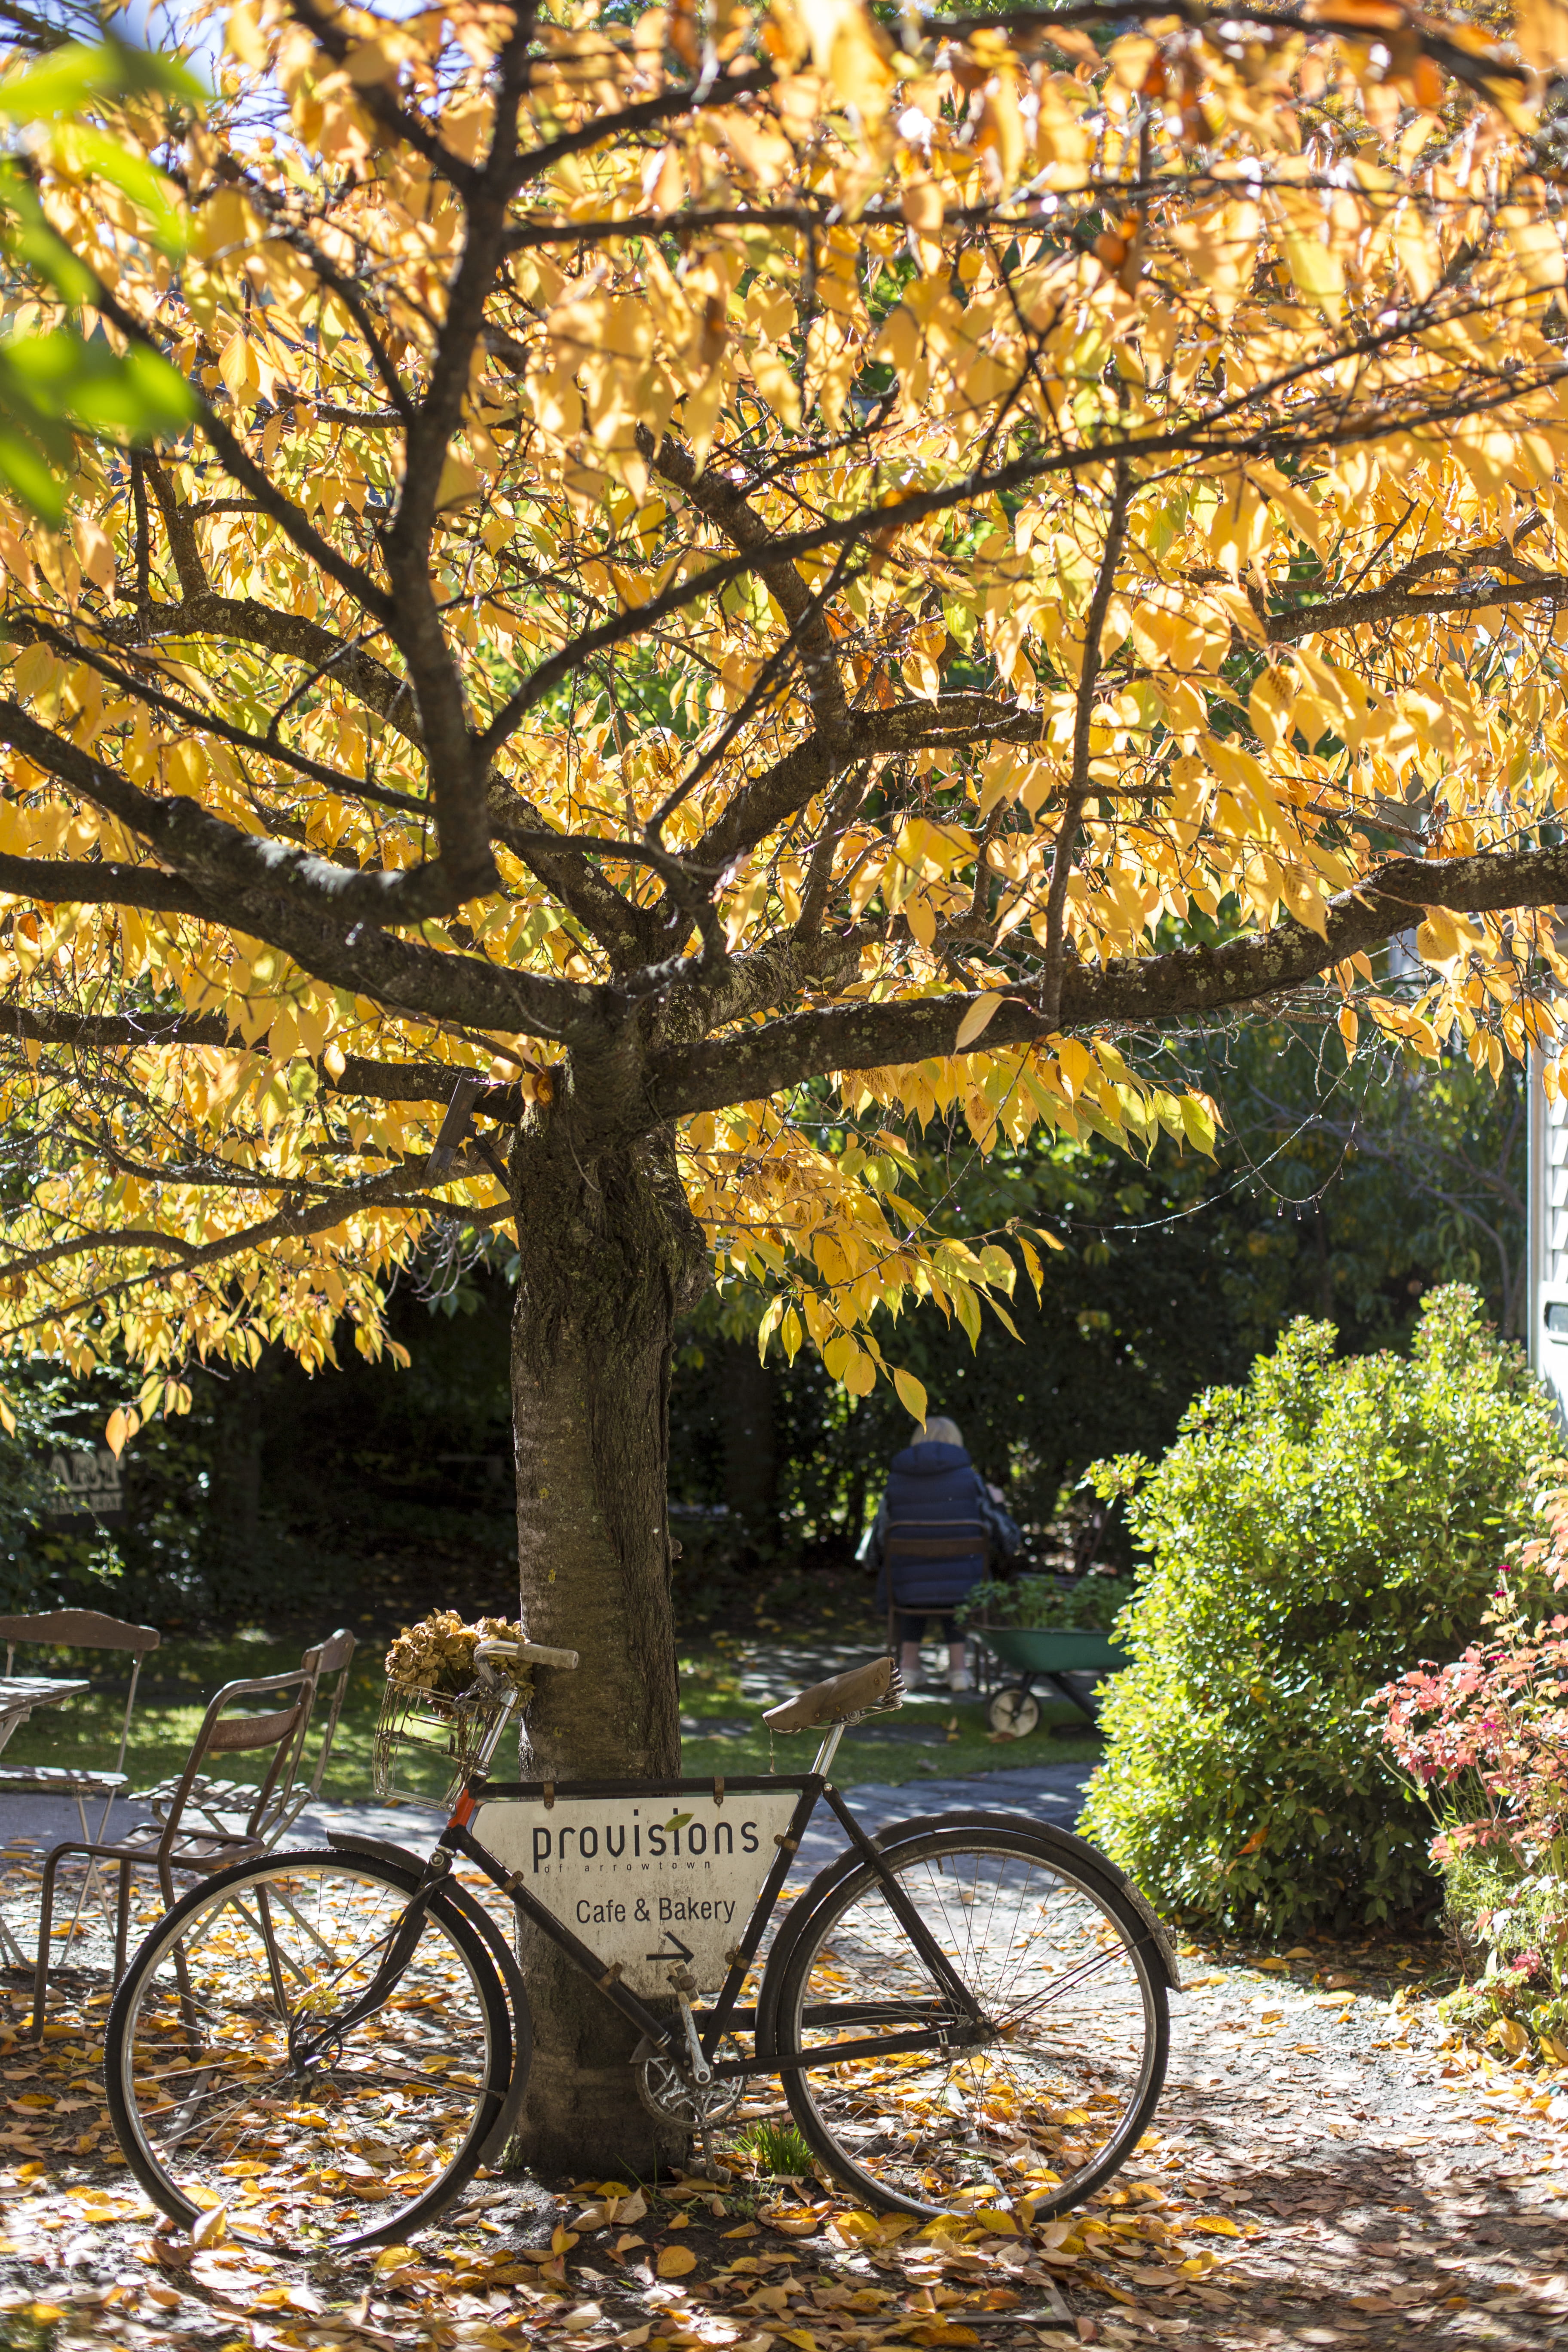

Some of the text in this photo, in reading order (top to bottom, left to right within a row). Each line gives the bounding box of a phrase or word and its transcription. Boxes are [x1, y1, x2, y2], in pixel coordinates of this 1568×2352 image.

[46, 1450, 126, 1491] ART
[533, 1808, 759, 1873] provisions
[544, 1861, 710, 1873] of arrowtown
[576, 1896, 736, 1923] Cafe & Bakery
